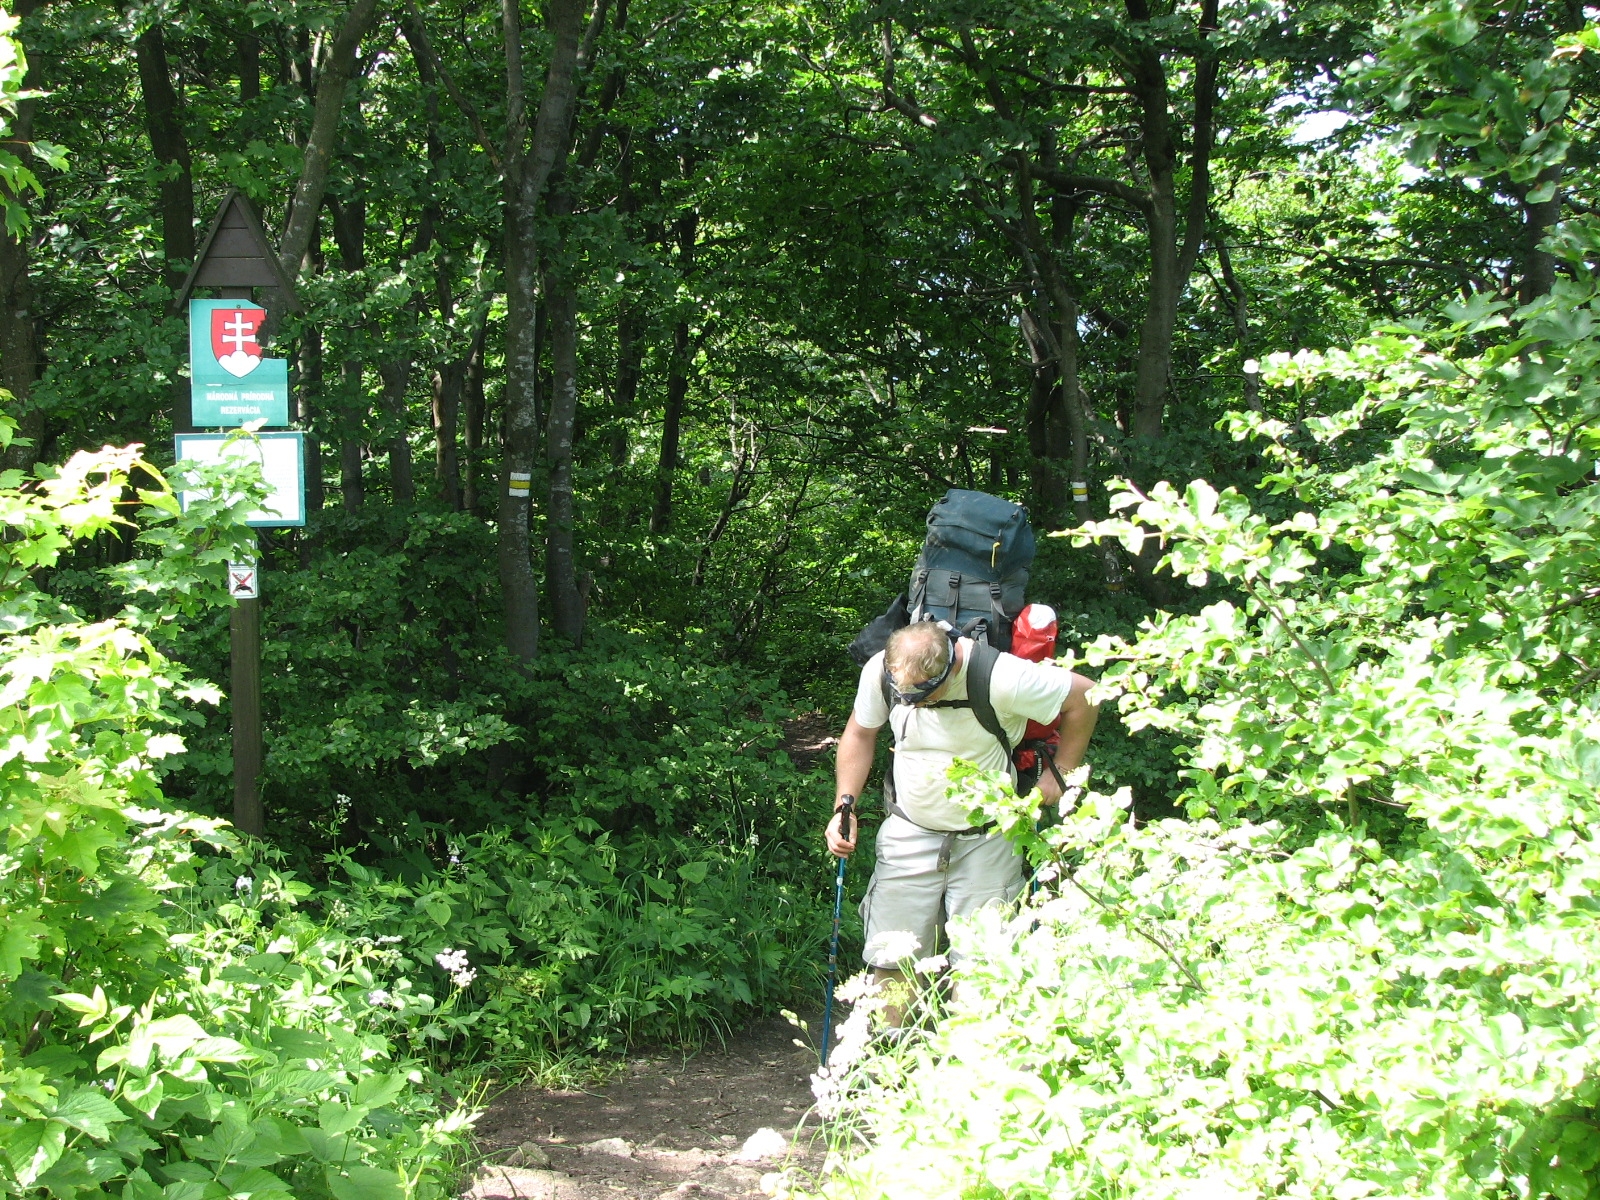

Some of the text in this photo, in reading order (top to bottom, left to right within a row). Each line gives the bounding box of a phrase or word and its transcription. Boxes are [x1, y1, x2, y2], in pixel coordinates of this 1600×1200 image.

[206, 391, 275, 401] NÁRODNÁ PRÍRODNÁ
[220, 405, 261, 415] REZERVÁCIA
